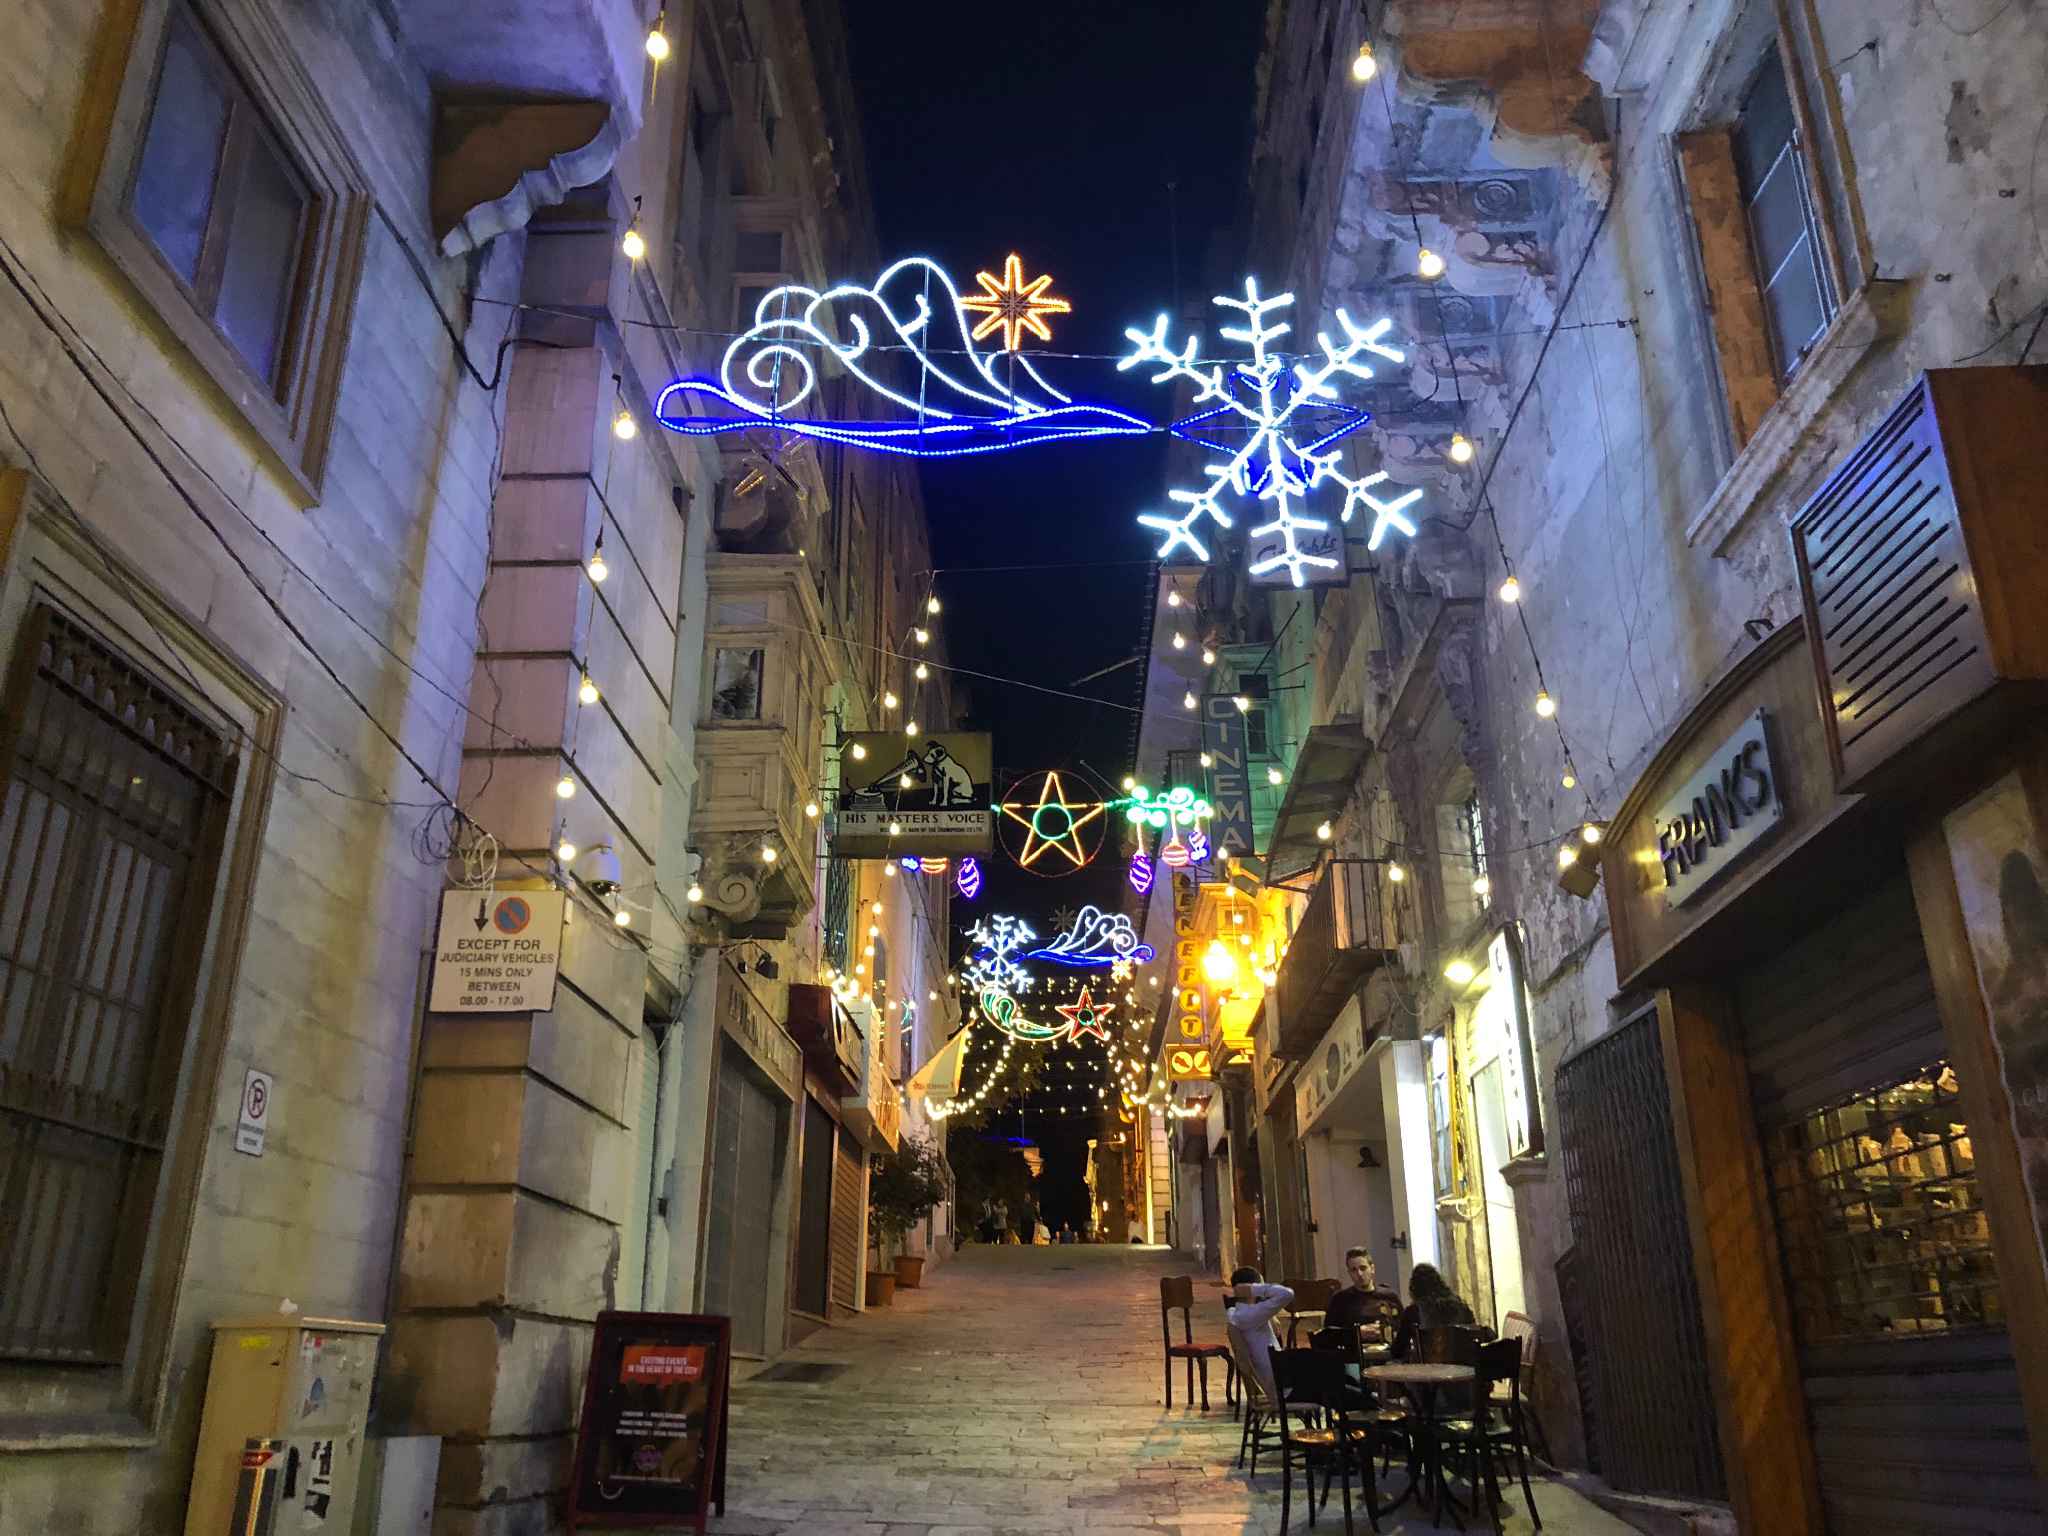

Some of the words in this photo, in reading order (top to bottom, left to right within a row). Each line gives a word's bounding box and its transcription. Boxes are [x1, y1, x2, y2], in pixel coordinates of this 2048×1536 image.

[1208, 696, 1247, 850] CINEMA
[1659, 739, 1768, 887] FRANKS
[845, 814, 866, 824] HIS
[877, 814, 938, 824] MASTERS
[947, 814, 985, 824] VOICE
[457, 939, 509, 950] EXCEPT
[514, 939, 541, 950] FOR
[440, 953, 498, 964] JUDICIARY
[502, 953, 554, 964] VEHICLES
[460, 968, 471, 977] 15
[474, 968, 501, 977] MINS
[505, 968, 533, 977] ONLY
[467, 982, 521, 992] BETWEEN
